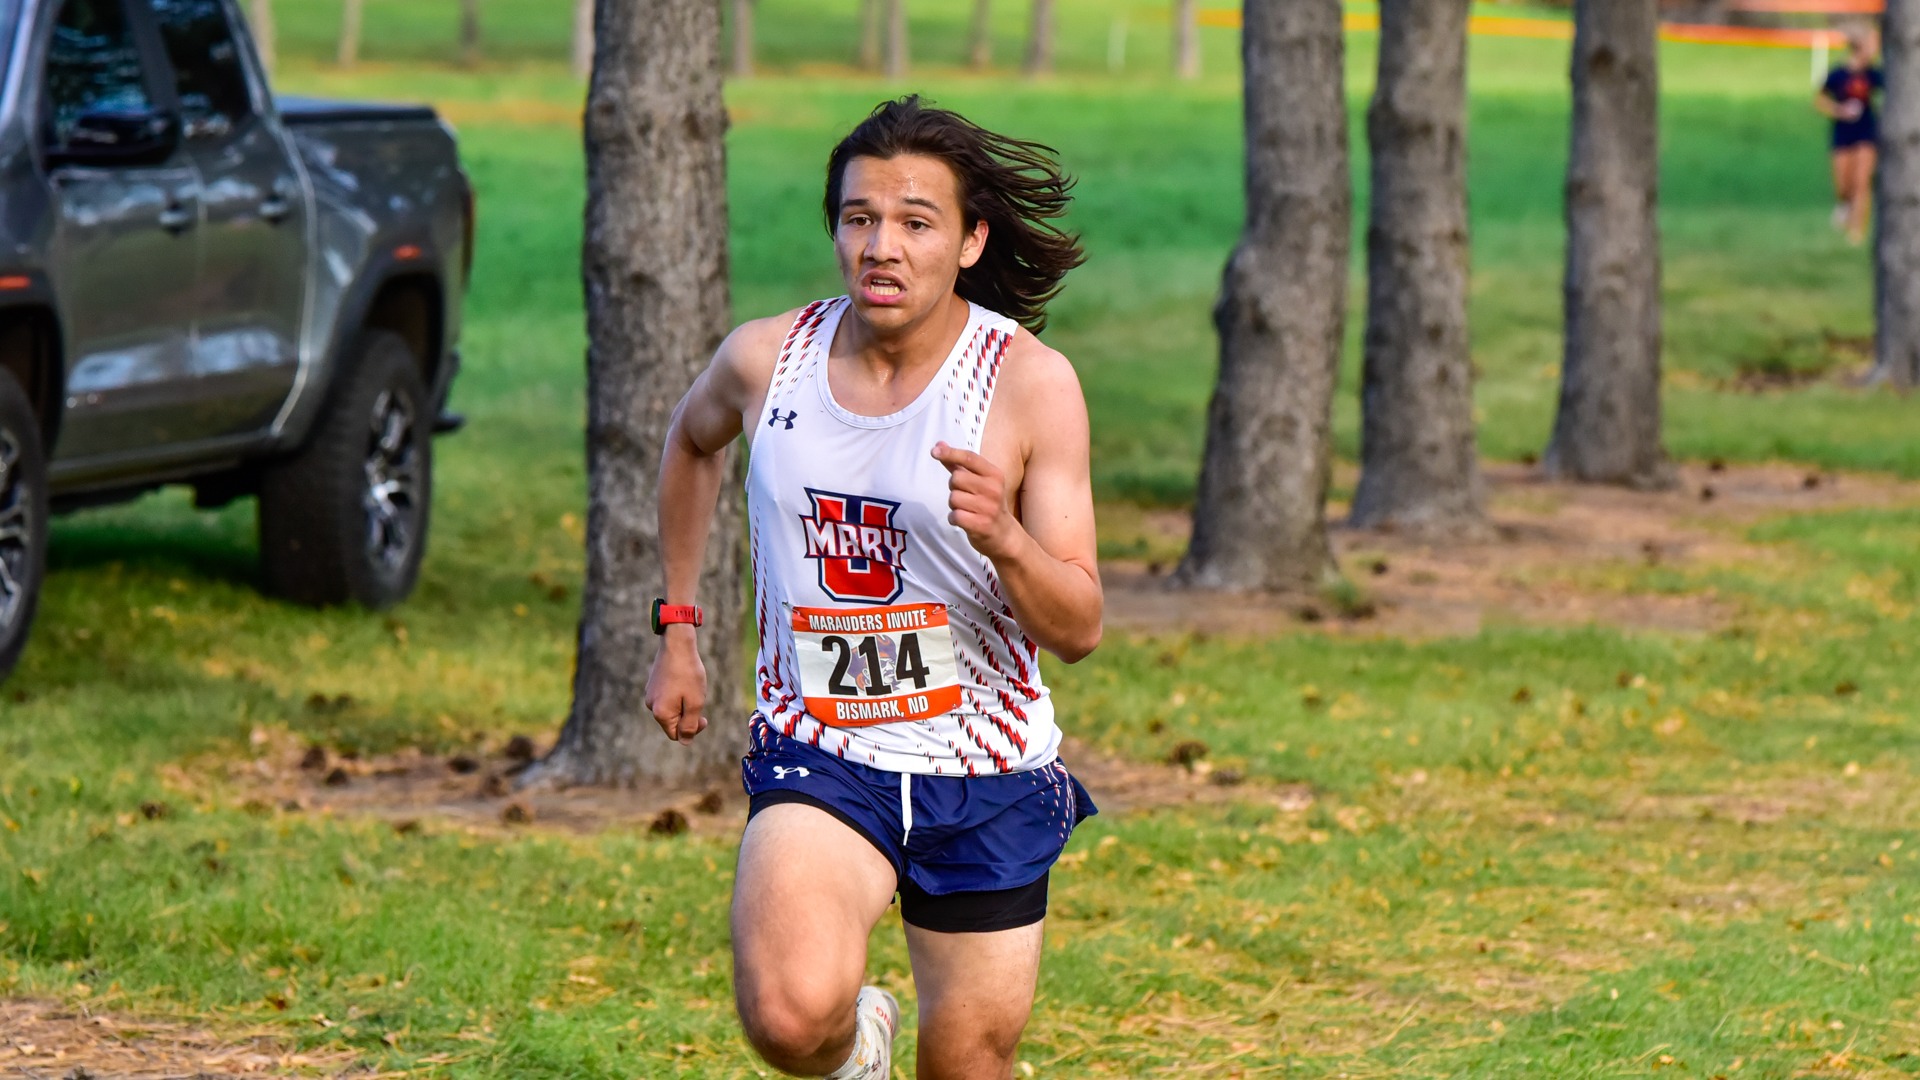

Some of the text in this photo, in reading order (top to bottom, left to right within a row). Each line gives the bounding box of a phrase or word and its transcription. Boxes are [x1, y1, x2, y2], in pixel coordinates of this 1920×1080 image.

[801, 517, 906, 570] MARY
[804, 487, 904, 605] U
[809, 610, 928, 632] MARAUDERS INVITE
[821, 632, 930, 696] 214
[836, 696, 929, 720] BISMARK, ND
